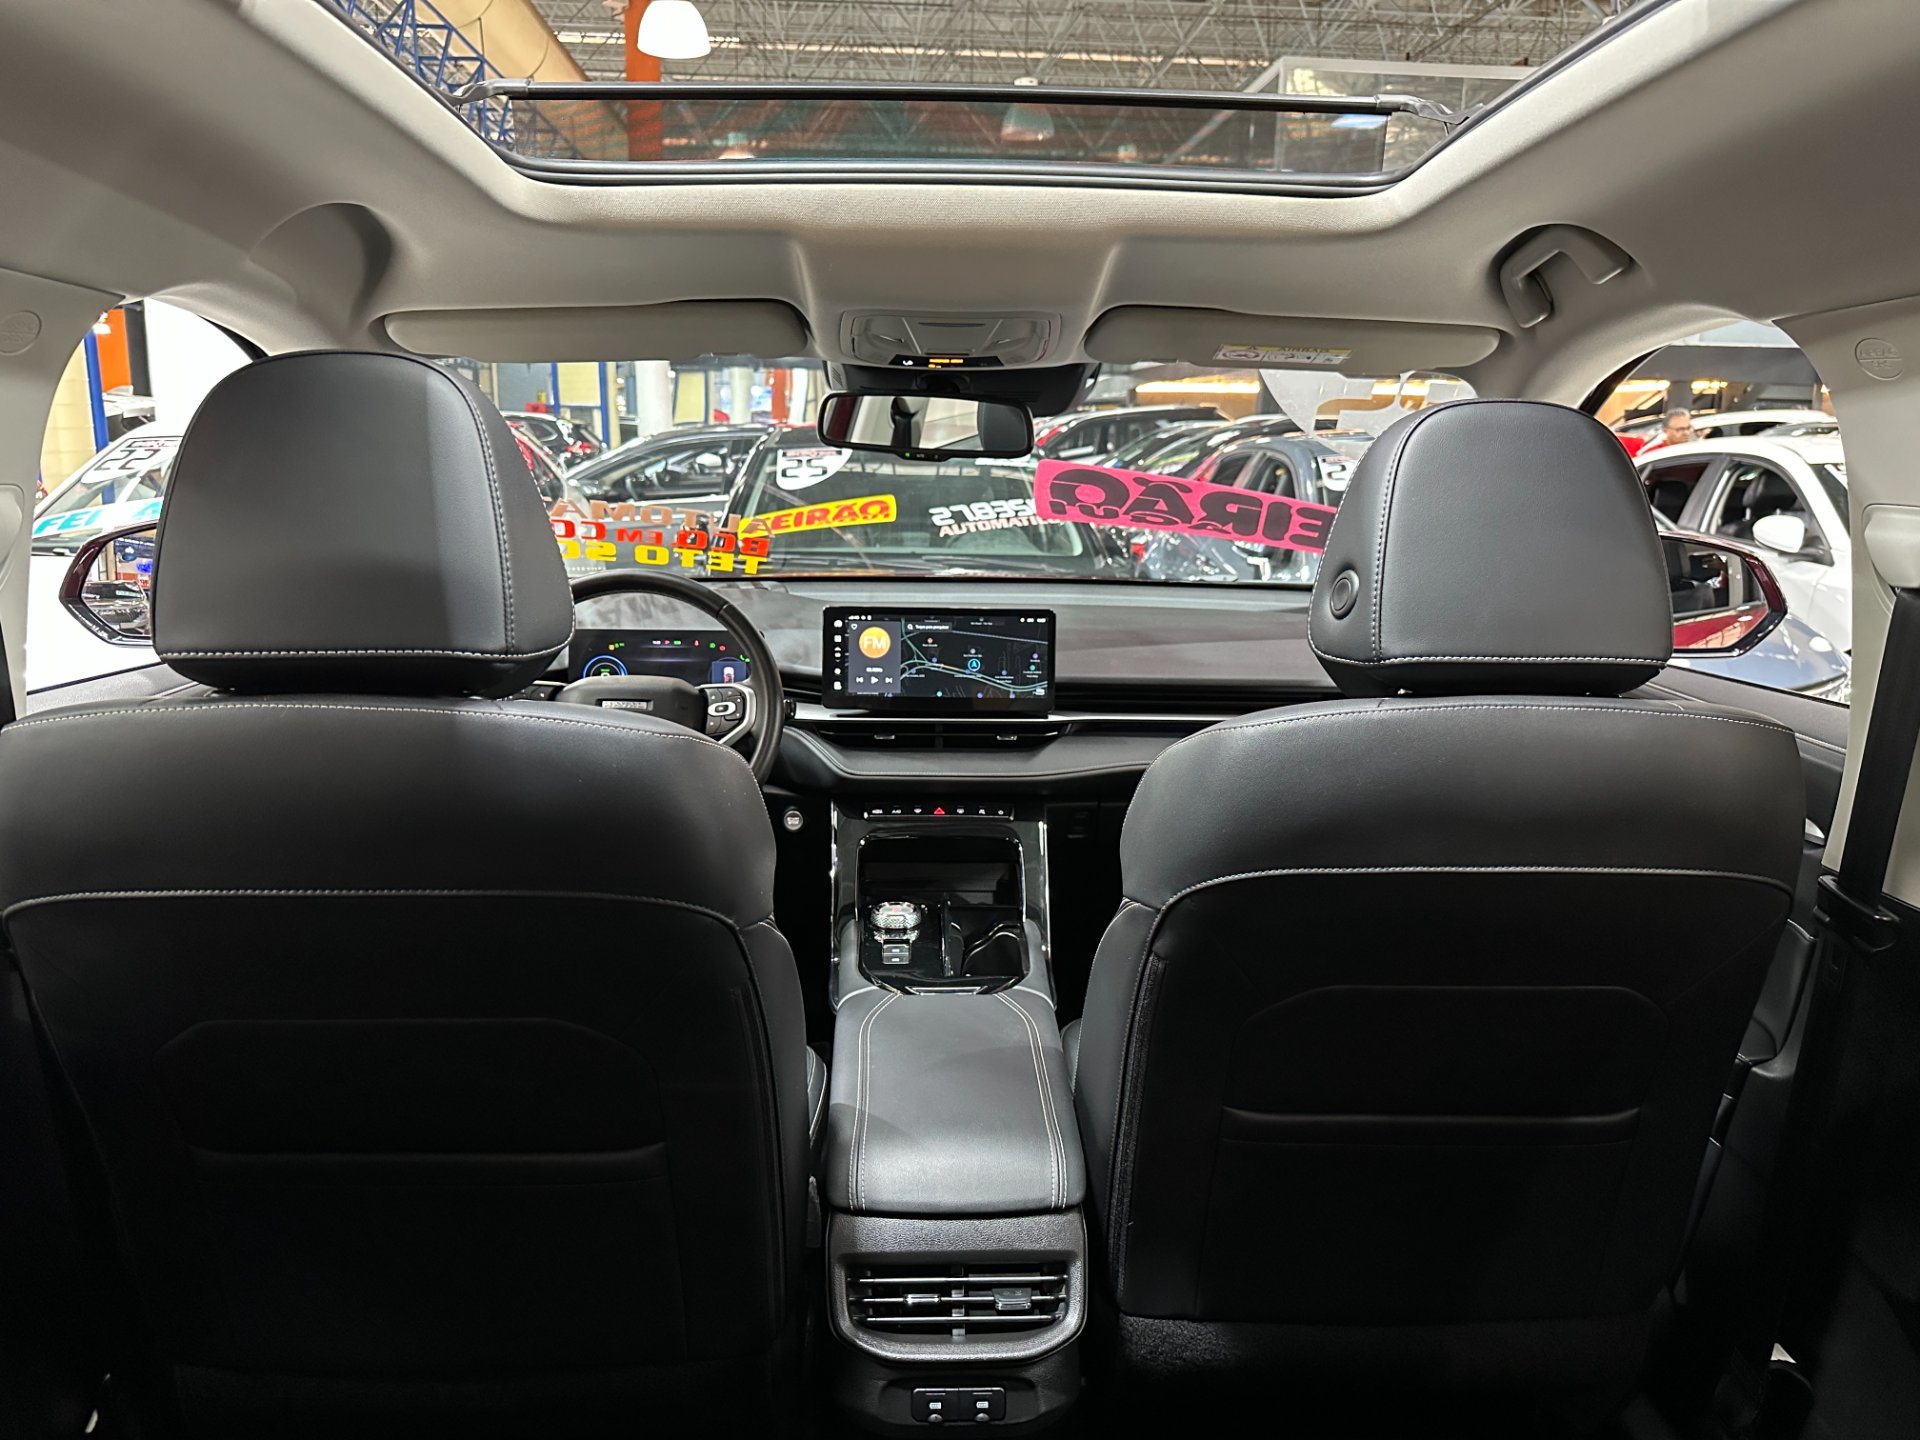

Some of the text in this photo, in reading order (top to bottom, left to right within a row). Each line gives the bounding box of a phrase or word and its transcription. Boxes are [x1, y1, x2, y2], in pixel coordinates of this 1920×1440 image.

[781, 457, 828, 478] 25
[763, 500, 889, 531] EIRÃO
[863, 636, 886, 649] FM
